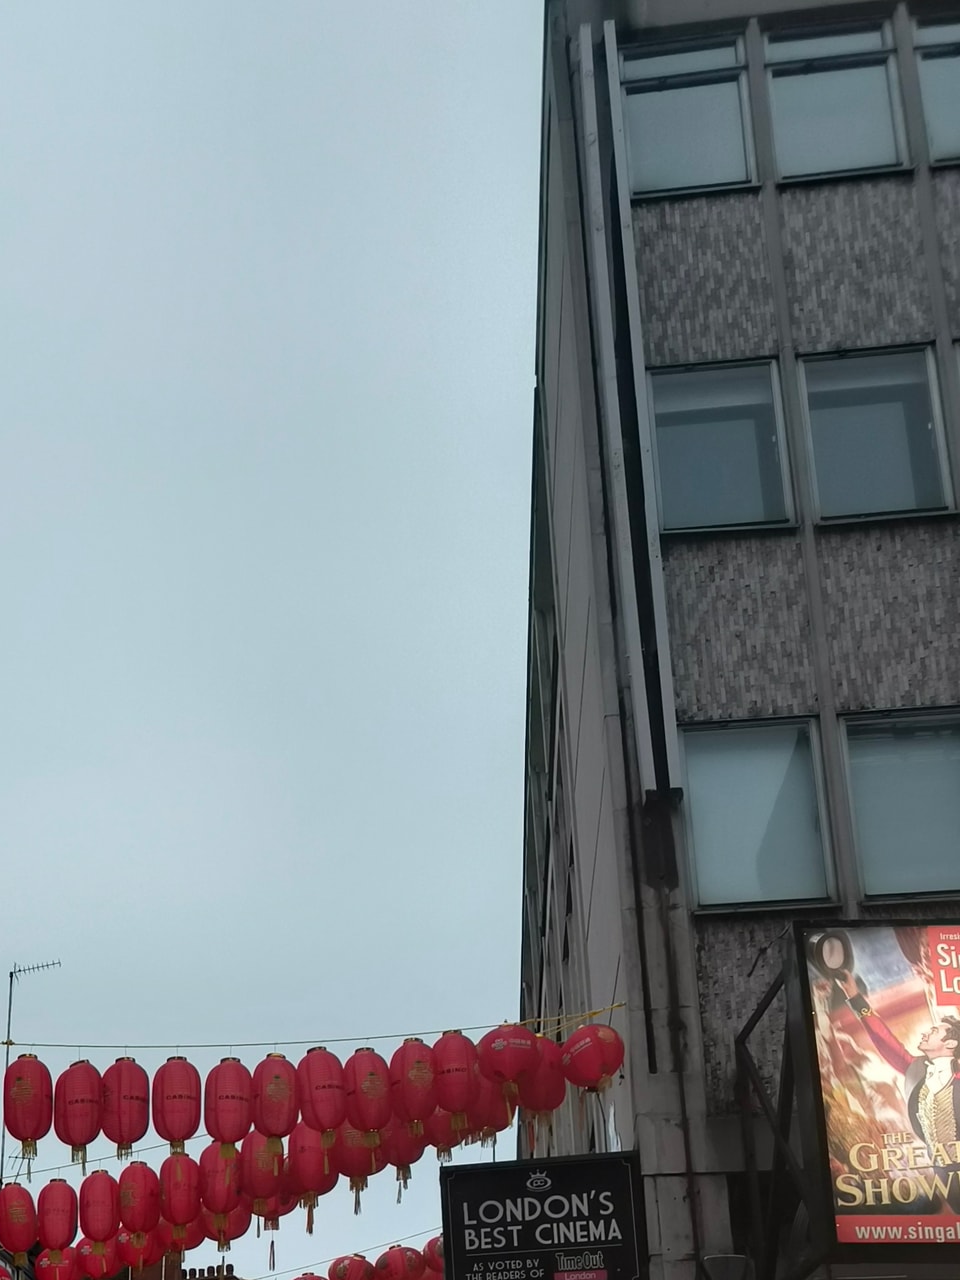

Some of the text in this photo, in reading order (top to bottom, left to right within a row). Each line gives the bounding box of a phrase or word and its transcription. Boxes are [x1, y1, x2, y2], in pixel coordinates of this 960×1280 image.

[881, 1132, 913, 1145] THE
[463, 1190, 615, 1225] LONDON'S
[464, 1218, 623, 1250] BEST CINEMA
[473, 1258, 540, 1272] AS VOTED BY
[486, 1270, 526, 1280] READERS
[530, 1268, 545, 1278] OF
[564, 1271, 597, 1280] London
